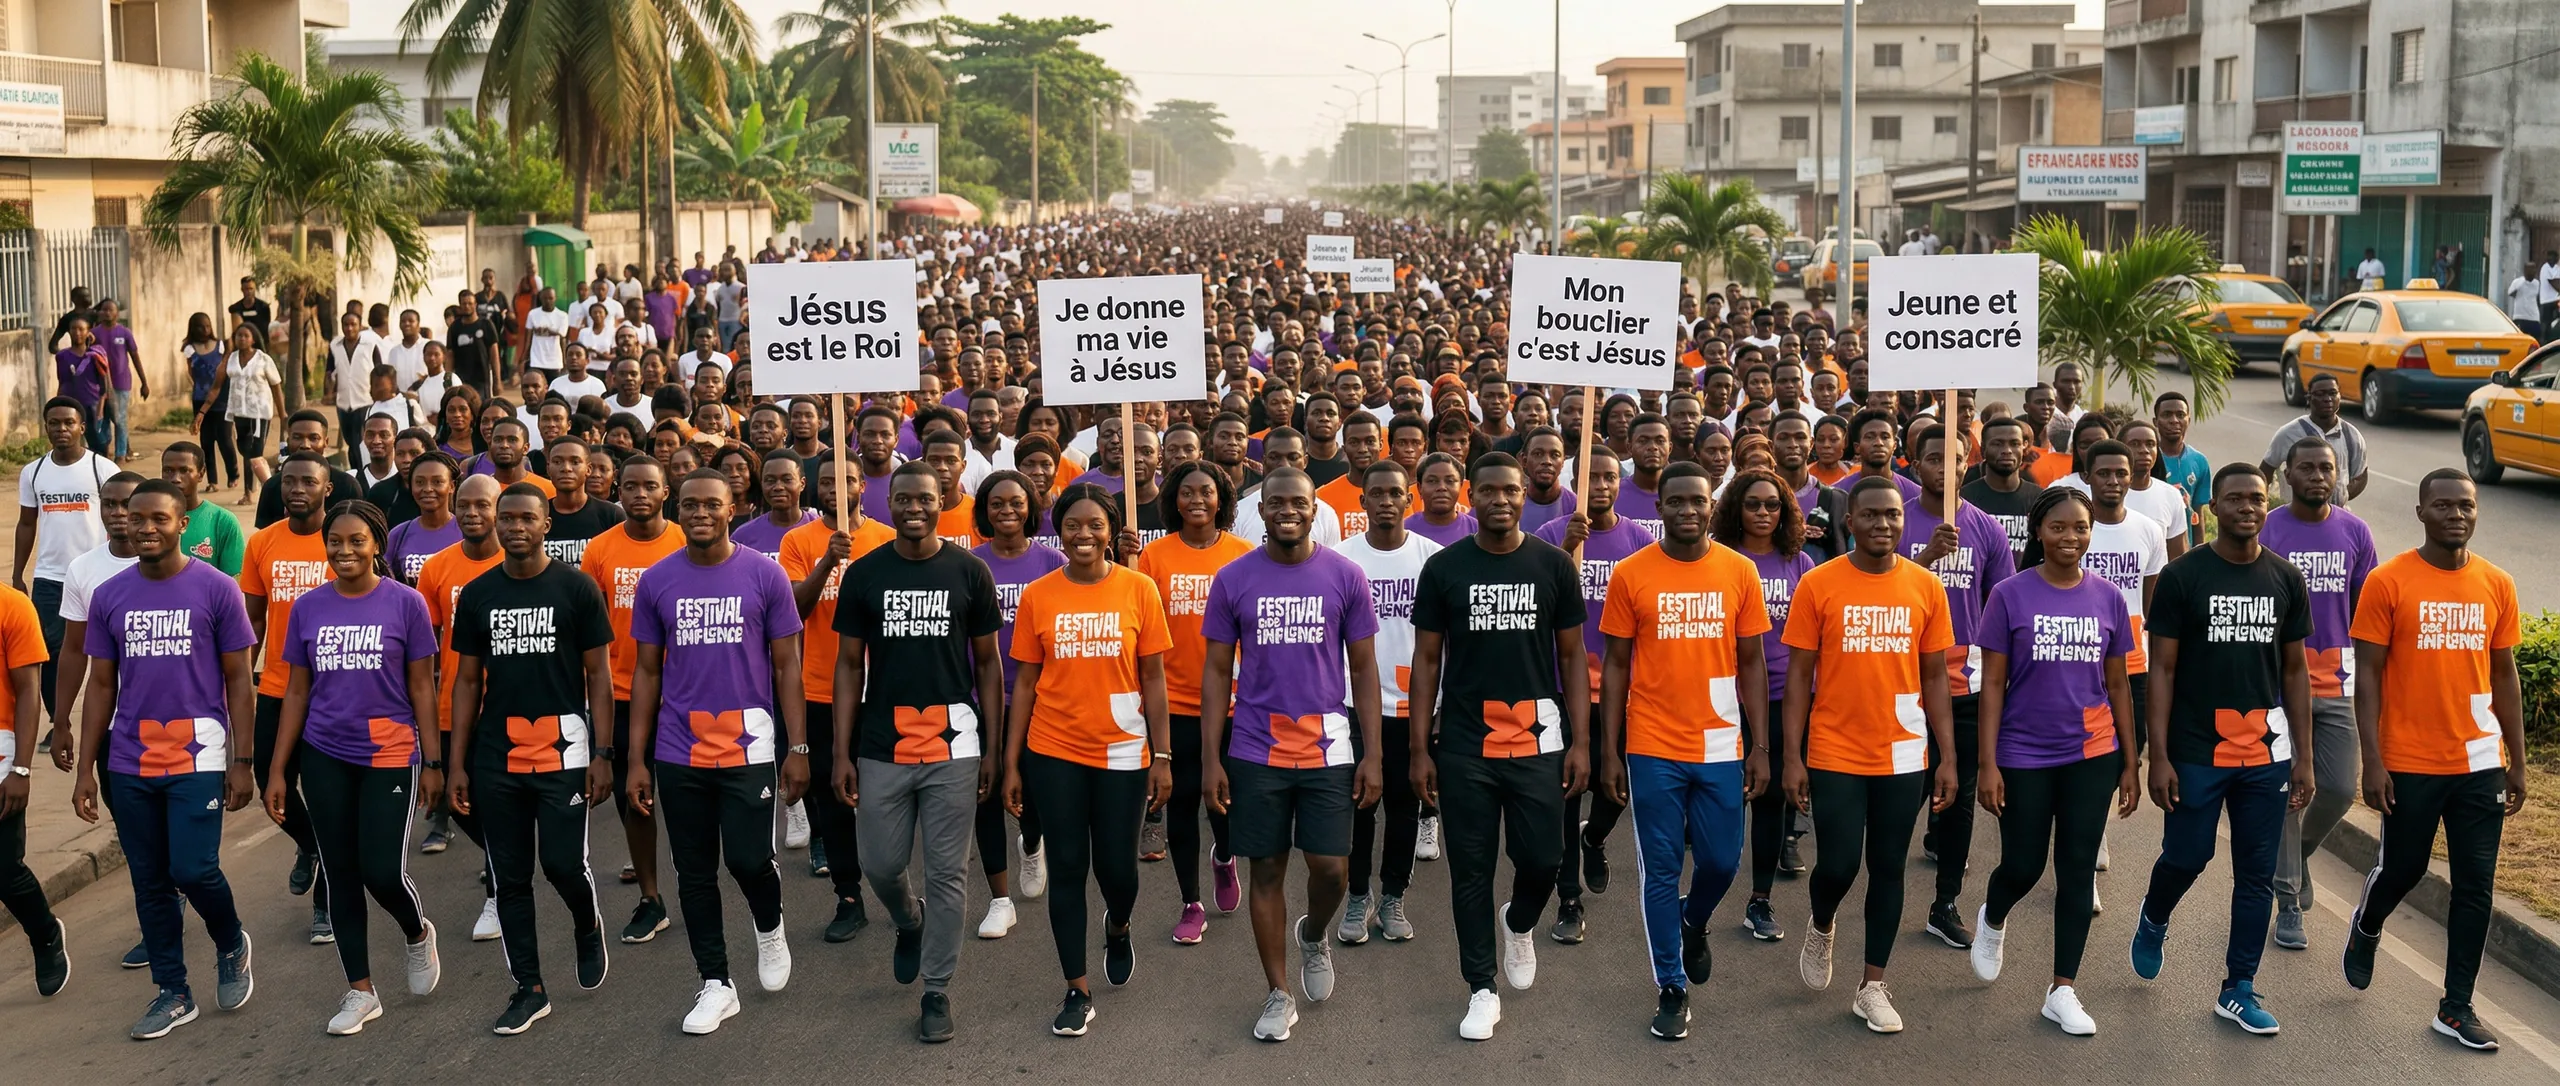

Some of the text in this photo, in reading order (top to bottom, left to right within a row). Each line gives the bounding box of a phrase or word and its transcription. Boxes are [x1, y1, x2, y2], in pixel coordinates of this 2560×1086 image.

[2109, 152, 2140, 169] NESS
[1564, 277, 1624, 303] Mon
[1888, 290, 2018, 317] Jeune et
[778, 293, 886, 326] Jésus
[1055, 296, 1185, 322] Je donne
[1537, 305, 1650, 335] bouclier
[768, 332, 901, 362] est le Roi
[1077, 325, 1168, 352] ma vie
[1885, 321, 2022, 350] consacré
[1517, 337, 1666, 367] c'est Jésus
[1070, 356, 1177, 383] à Jésus
[272, 560, 329, 586] FESTIVAL
[2086, 552, 2140, 573] FESTIVAL
[676, 596, 744, 627] FESTIVAL
[883, 589, 950, 619] FESTIVAL
[1257, 596, 1326, 626] FESTIVAL
[1470, 583, 1537, 613] FESTIVAL
[1657, 592, 1726, 622] FESTIVAL
[2209, 595, 2277, 625] FESTIVAL
[125, 609, 192, 639] FESTIVAL
[490, 607, 556, 637] FESTIVAL
[1055, 612, 1123, 642] FESTIVAL
[1843, 605, 1912, 635] FESTIVAL
[2034, 615, 2102, 645] FESTIVAL
[2419, 601, 2487, 631] FESTIVAL
[317, 625, 383, 653] FESTIVAL
